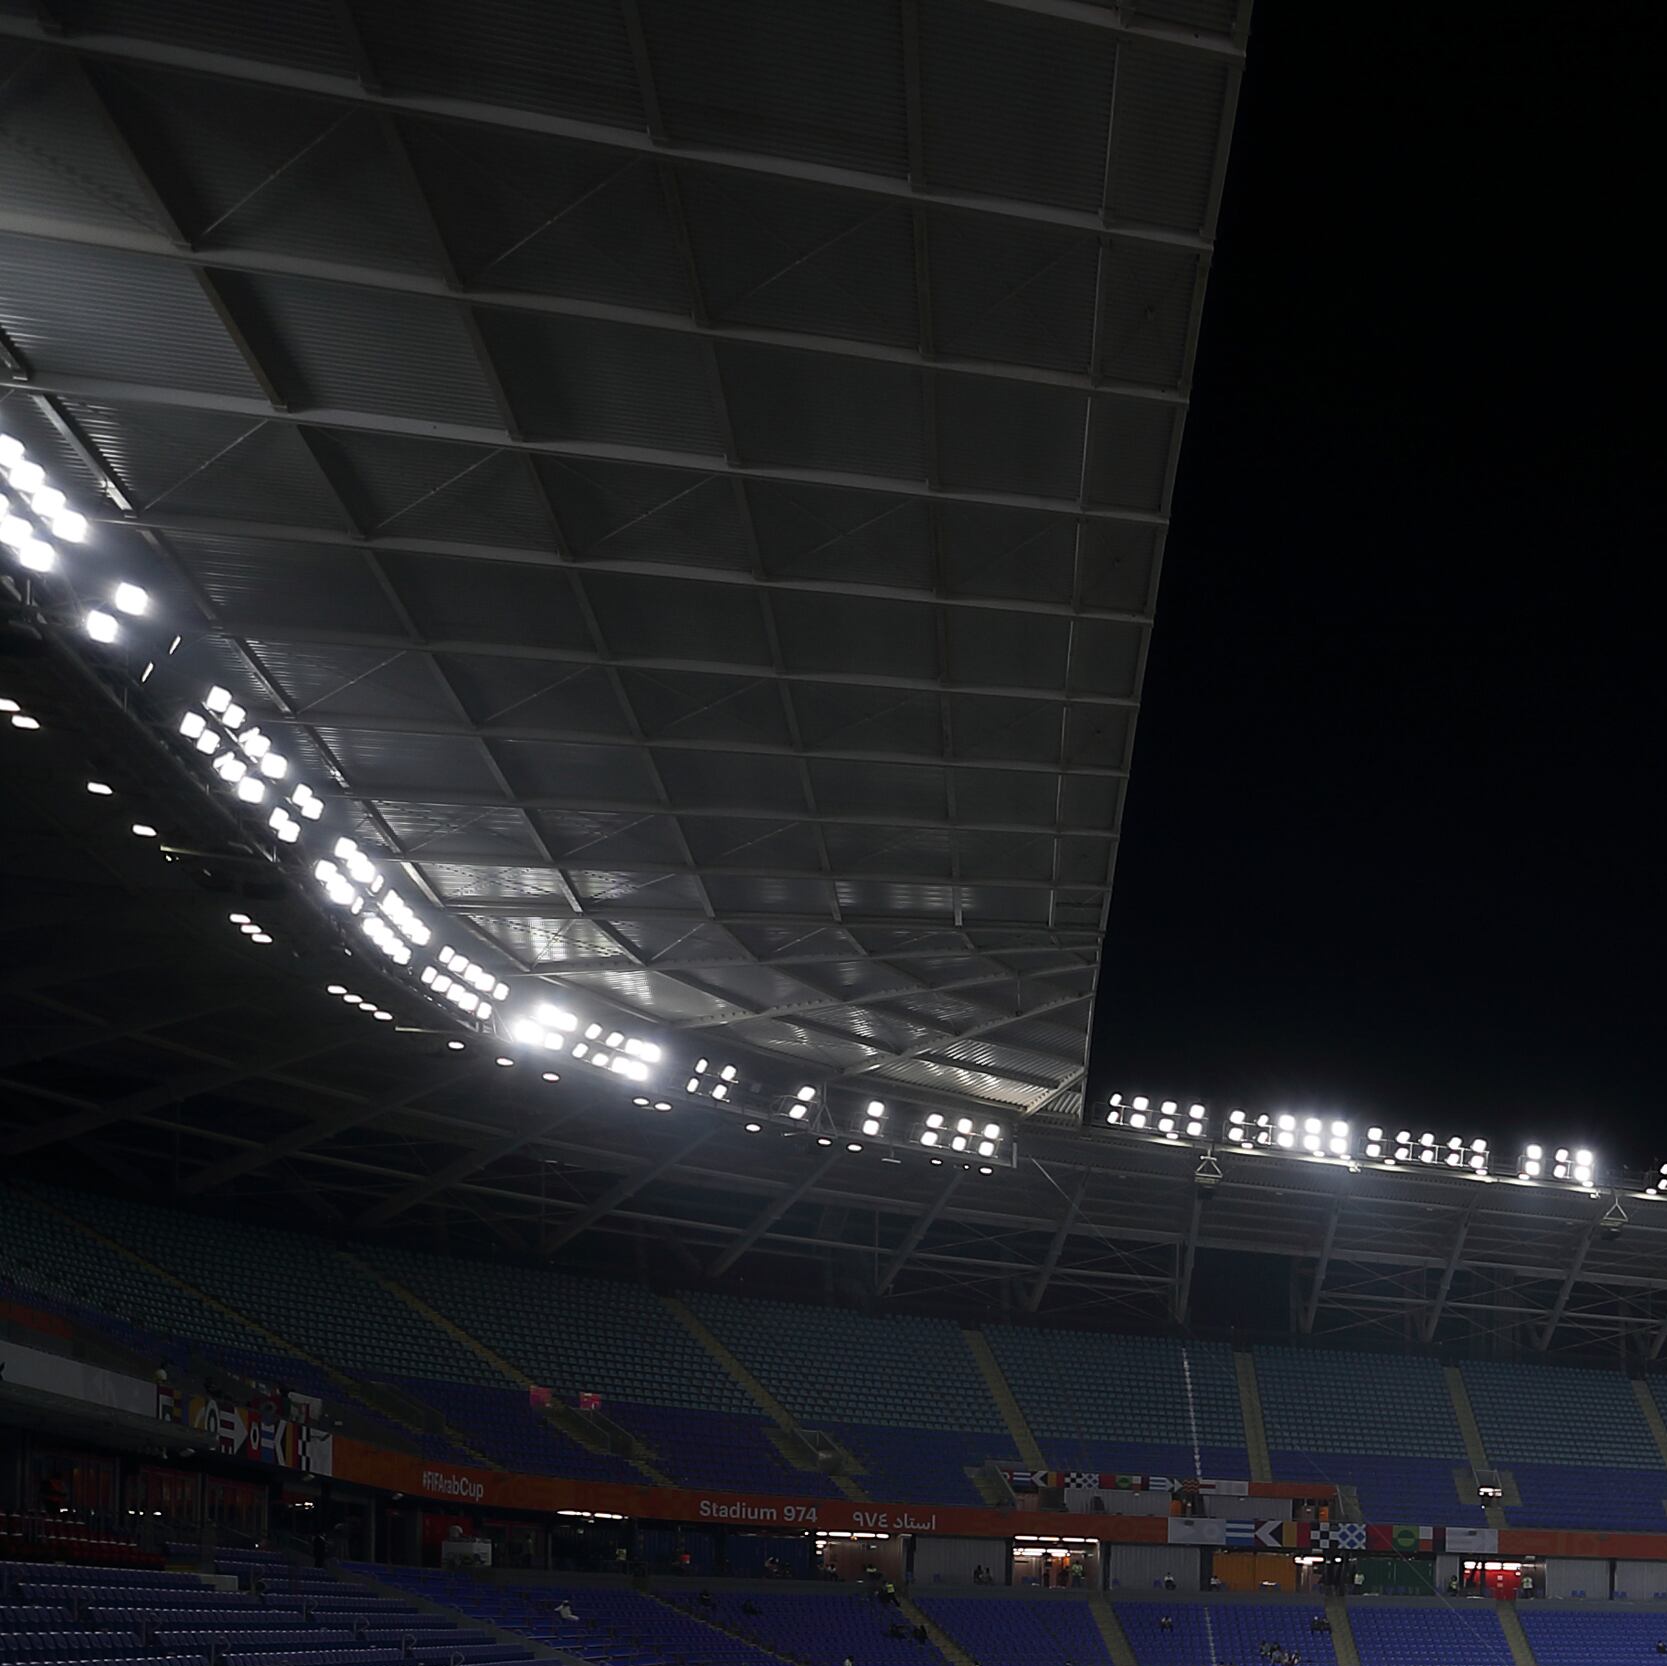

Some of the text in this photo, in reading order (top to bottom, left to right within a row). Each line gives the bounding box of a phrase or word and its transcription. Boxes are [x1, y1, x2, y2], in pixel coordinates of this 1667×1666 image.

[699, 1500, 818, 1523] Stadium 974
[852, 1511, 936, 1530] استاد ٩٧٤
